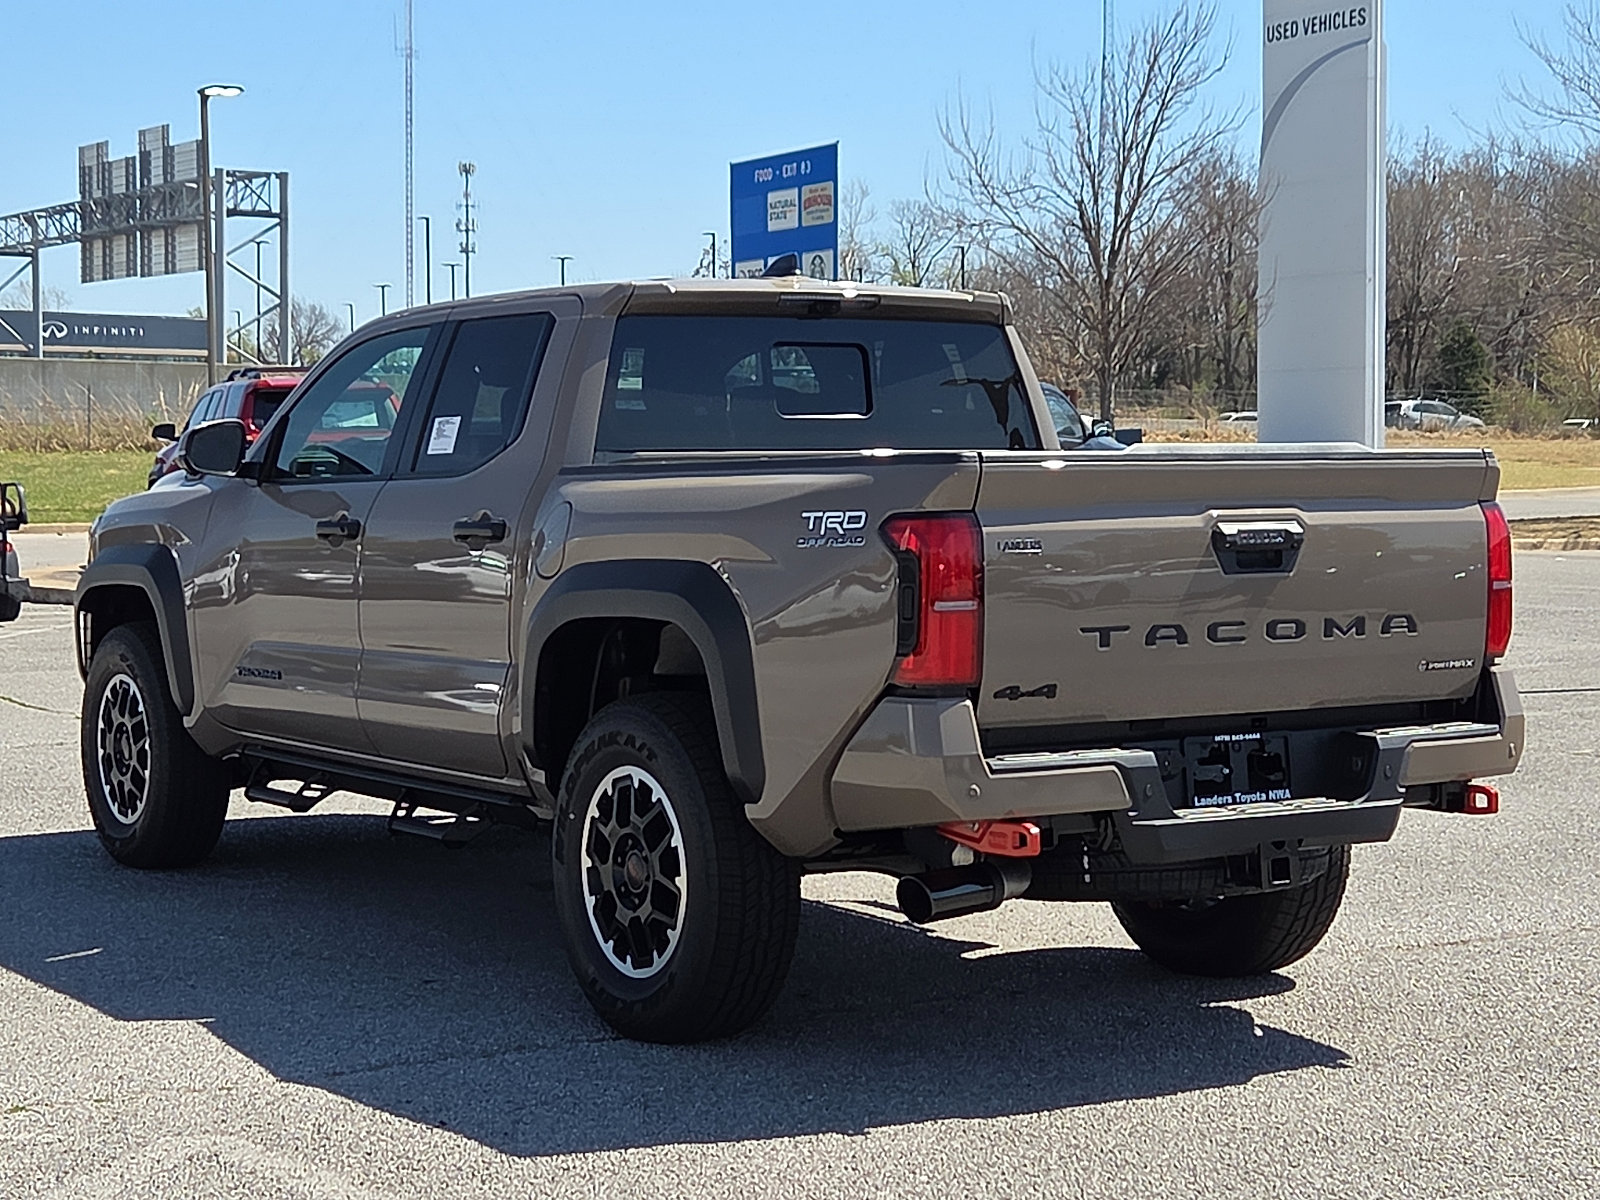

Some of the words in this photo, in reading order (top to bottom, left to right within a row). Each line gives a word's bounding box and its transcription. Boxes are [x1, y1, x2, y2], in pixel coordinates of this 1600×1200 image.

[1266, 20, 1299, 43] USED
[1302, 7, 1367, 36] VEHICLES
[754, 167, 773, 183] FOOD
[782, 162, 797, 179] EXIT
[769, 198, 797, 210] NATURAL
[769, 210, 787, 221] STATE
[73, 325, 145, 337] INFINITI
[801, 511, 867, 536] TRD
[1079, 613, 1419, 651] TACOMA
[1194, 794, 1232, 807] Landers
[1234, 791, 1267, 804] Toyota
[1268, 788, 1292, 801] NWA
